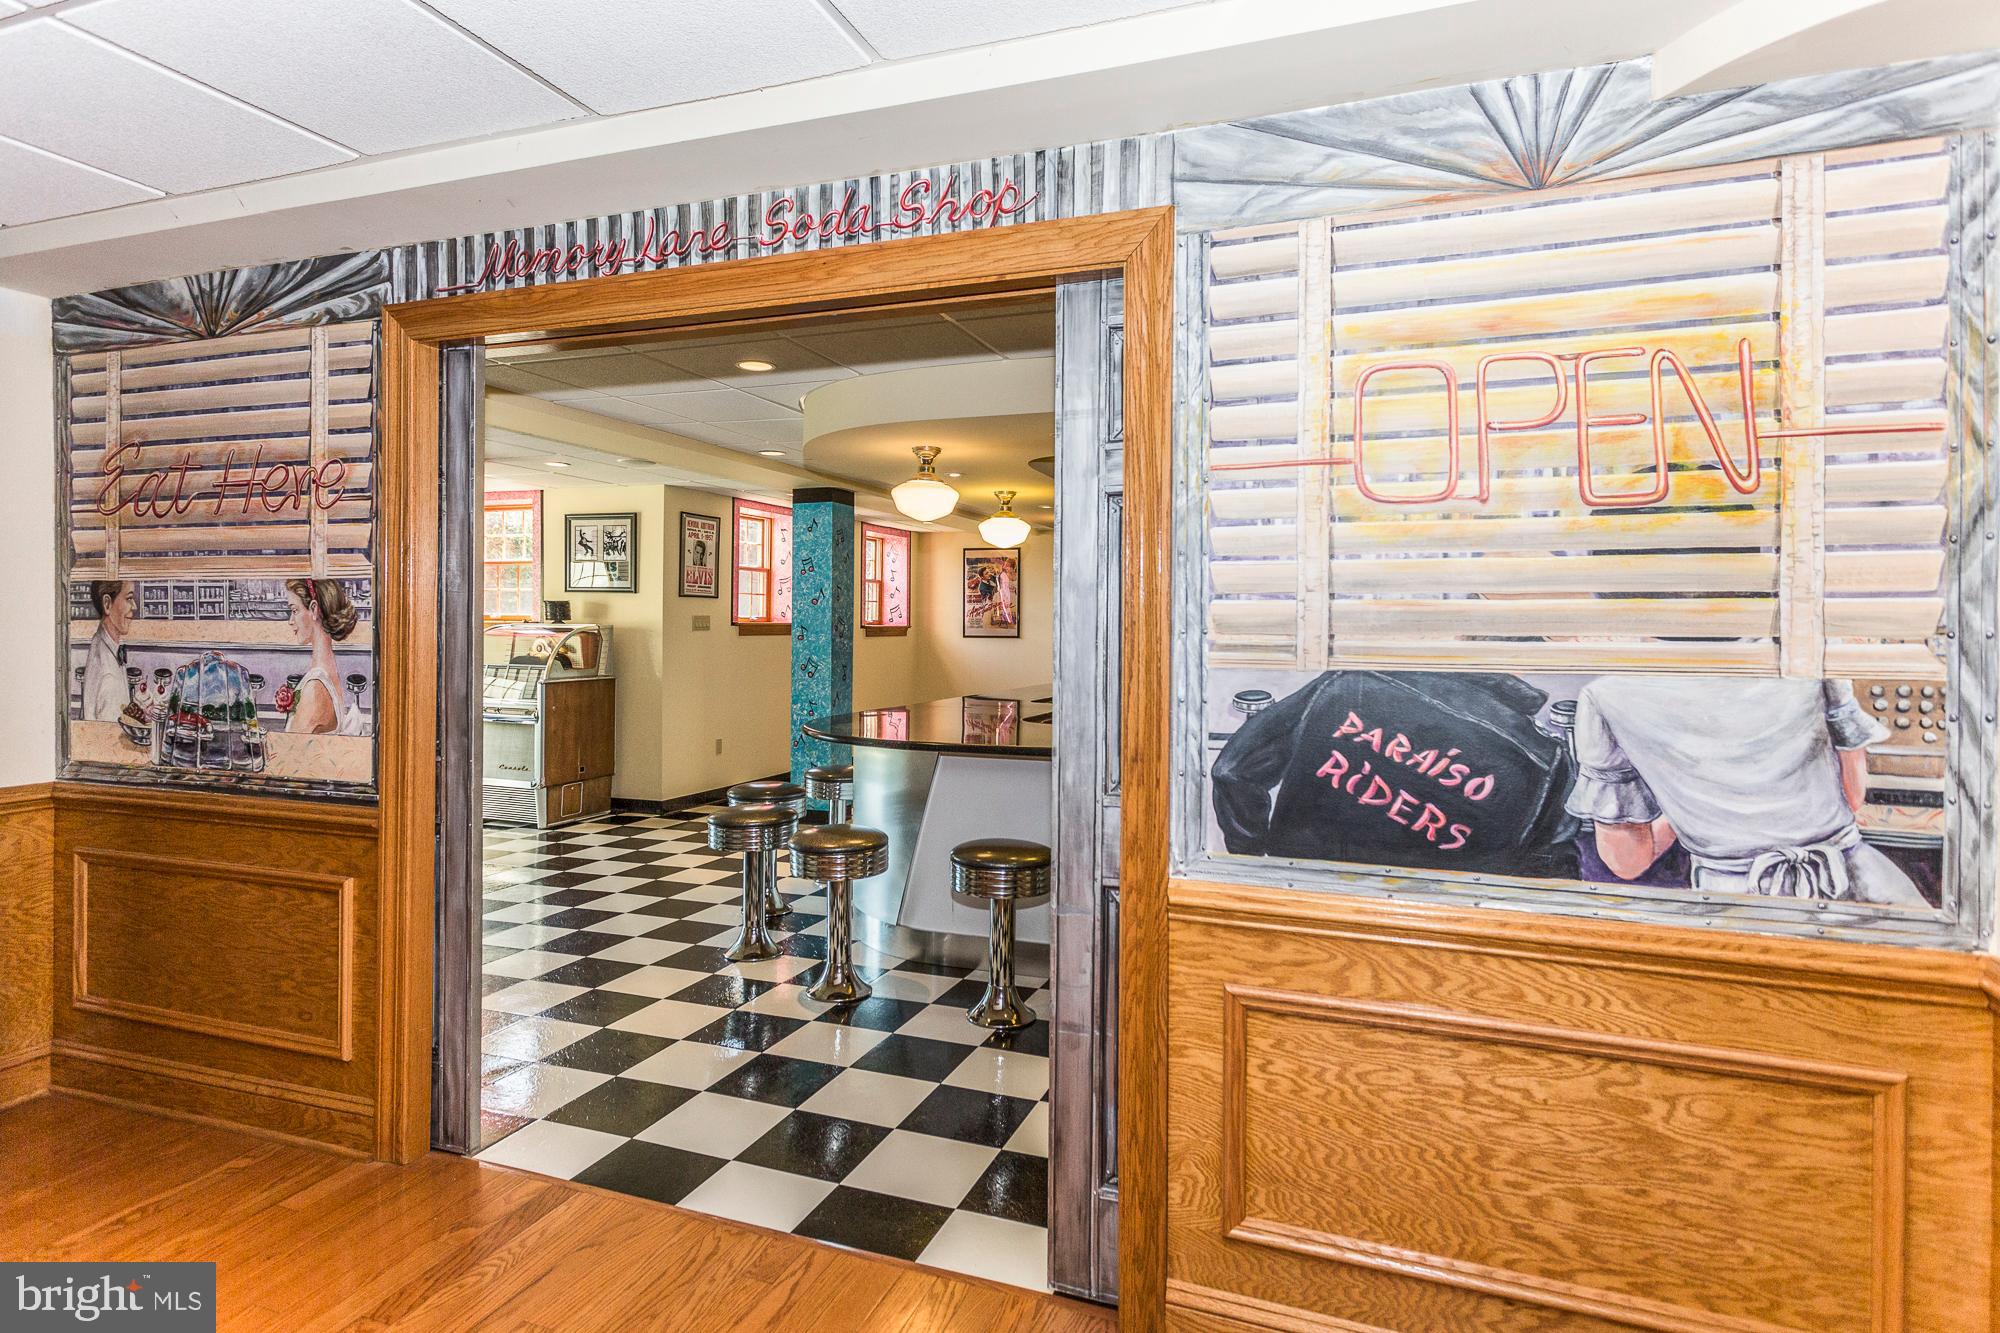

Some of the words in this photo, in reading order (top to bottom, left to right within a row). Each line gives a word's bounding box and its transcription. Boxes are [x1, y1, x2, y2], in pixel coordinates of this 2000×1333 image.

[470, 236, 628, 288] Memory
[638, 216, 734, 263] Lane
[761, 187, 872, 247] Soda
[892, 175, 1038, 228] Shop
[1353, 338, 1760, 507] OPEN
[97, 440, 202, 517] Eat
[211, 443, 347, 515] Here
[686, 569, 713, 586] ELVIS
